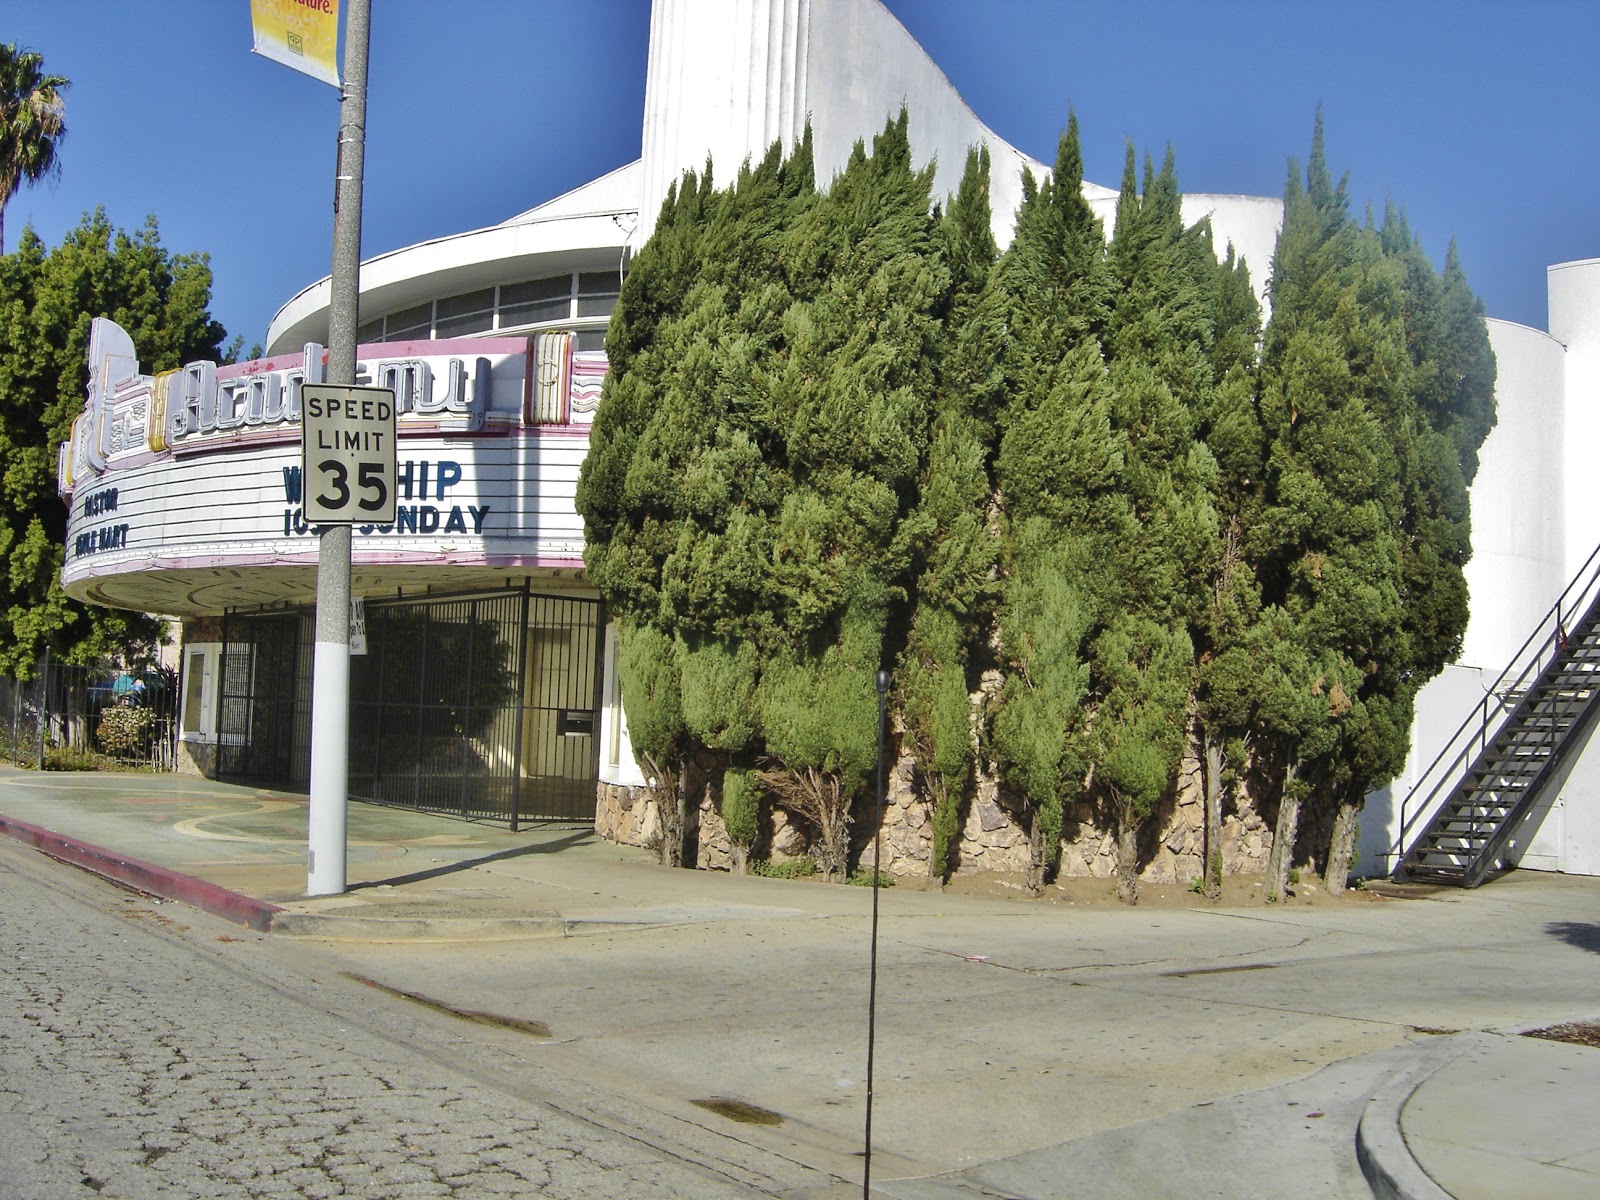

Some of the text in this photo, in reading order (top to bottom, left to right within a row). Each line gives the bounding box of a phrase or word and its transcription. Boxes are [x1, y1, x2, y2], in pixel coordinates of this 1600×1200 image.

[308, 398, 391, 421] SPEED
[318, 430, 384, 451] LIMIT
[283, 460, 462, 504] WHIP
[315, 459, 388, 511] 35
